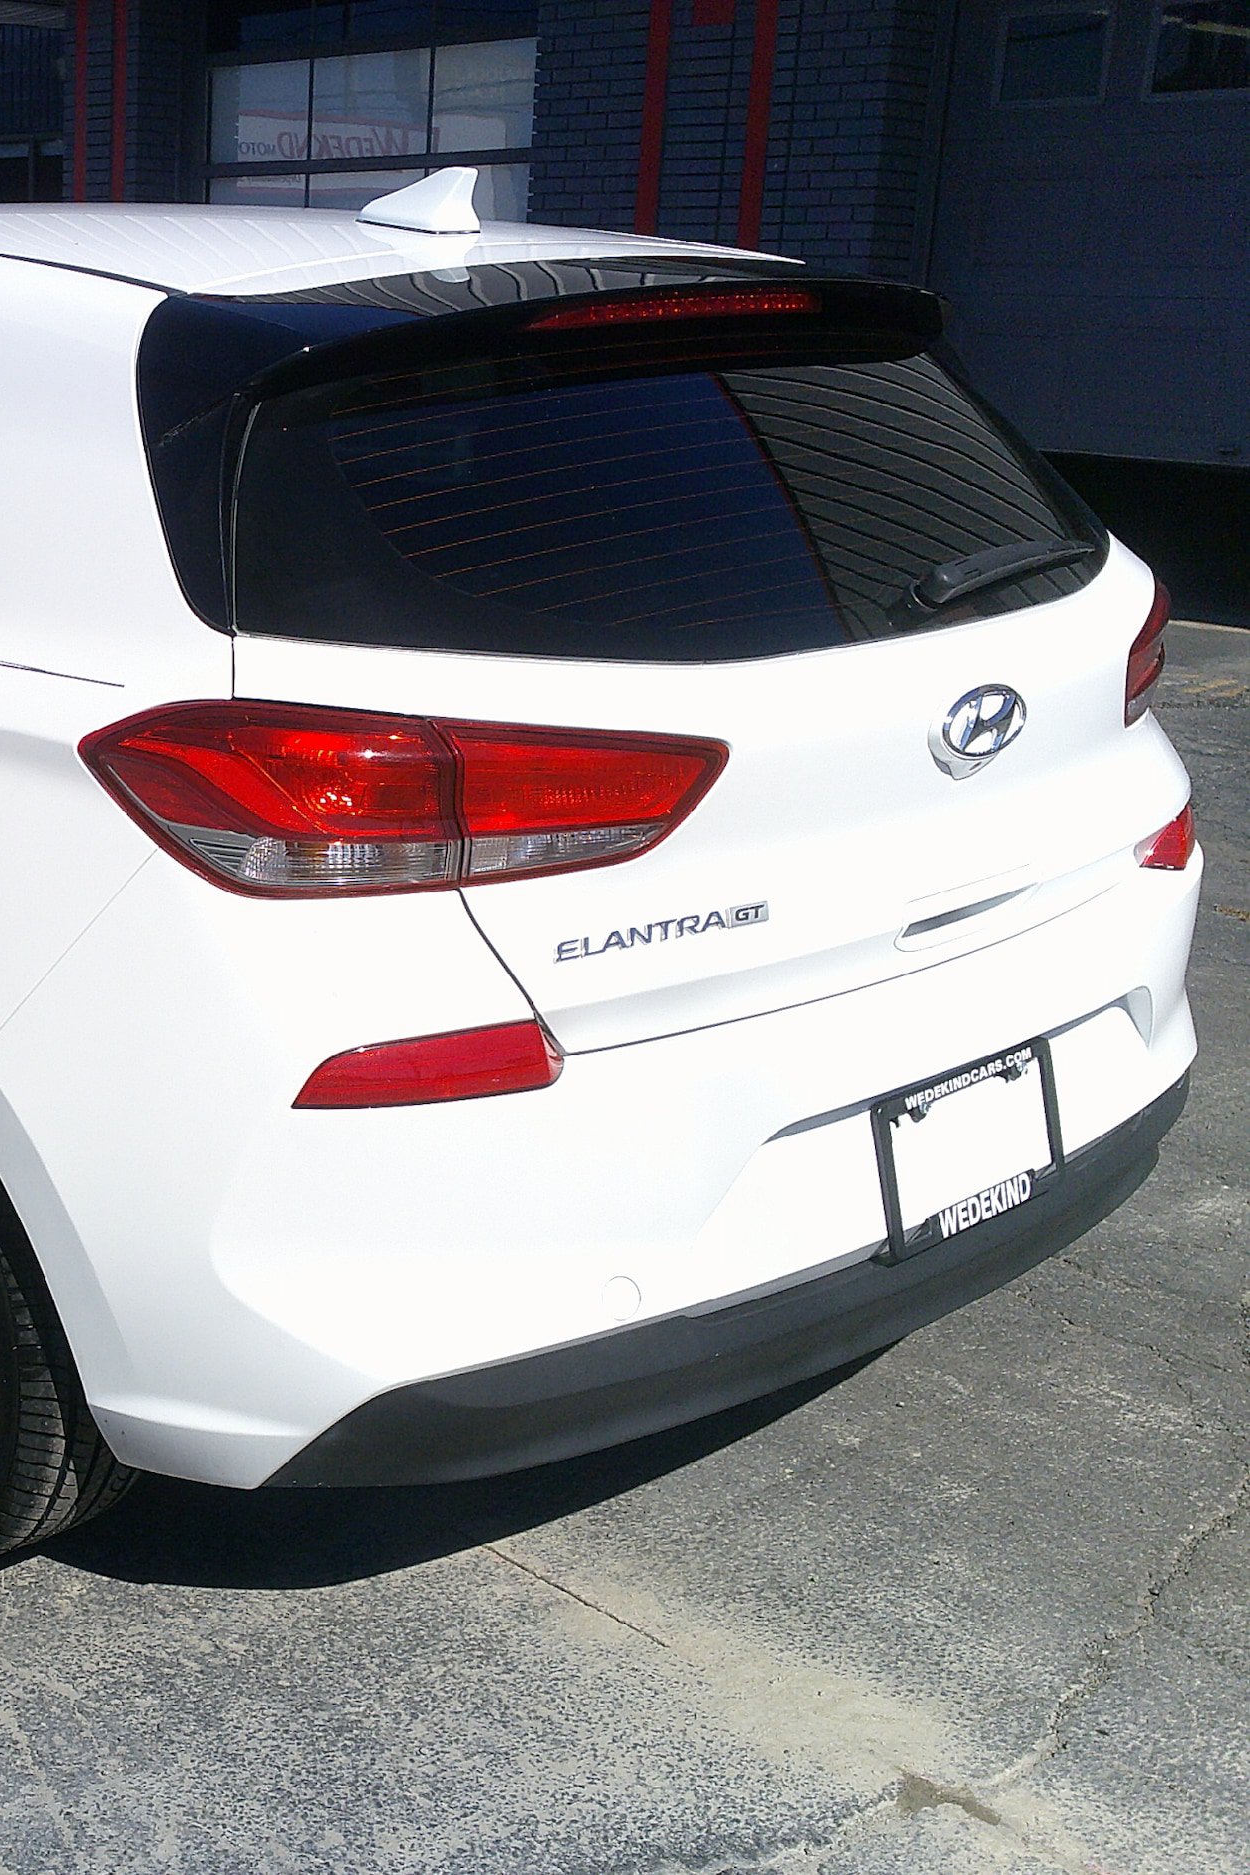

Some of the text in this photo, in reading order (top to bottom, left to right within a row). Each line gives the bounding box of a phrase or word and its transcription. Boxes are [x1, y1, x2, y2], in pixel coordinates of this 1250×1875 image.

[553, 904, 765, 963] ELANTRA GT
[904, 1046, 1032, 1110] WEDEKINDCARS.COM
[938, 1172, 1032, 1239] WEDEKIND
